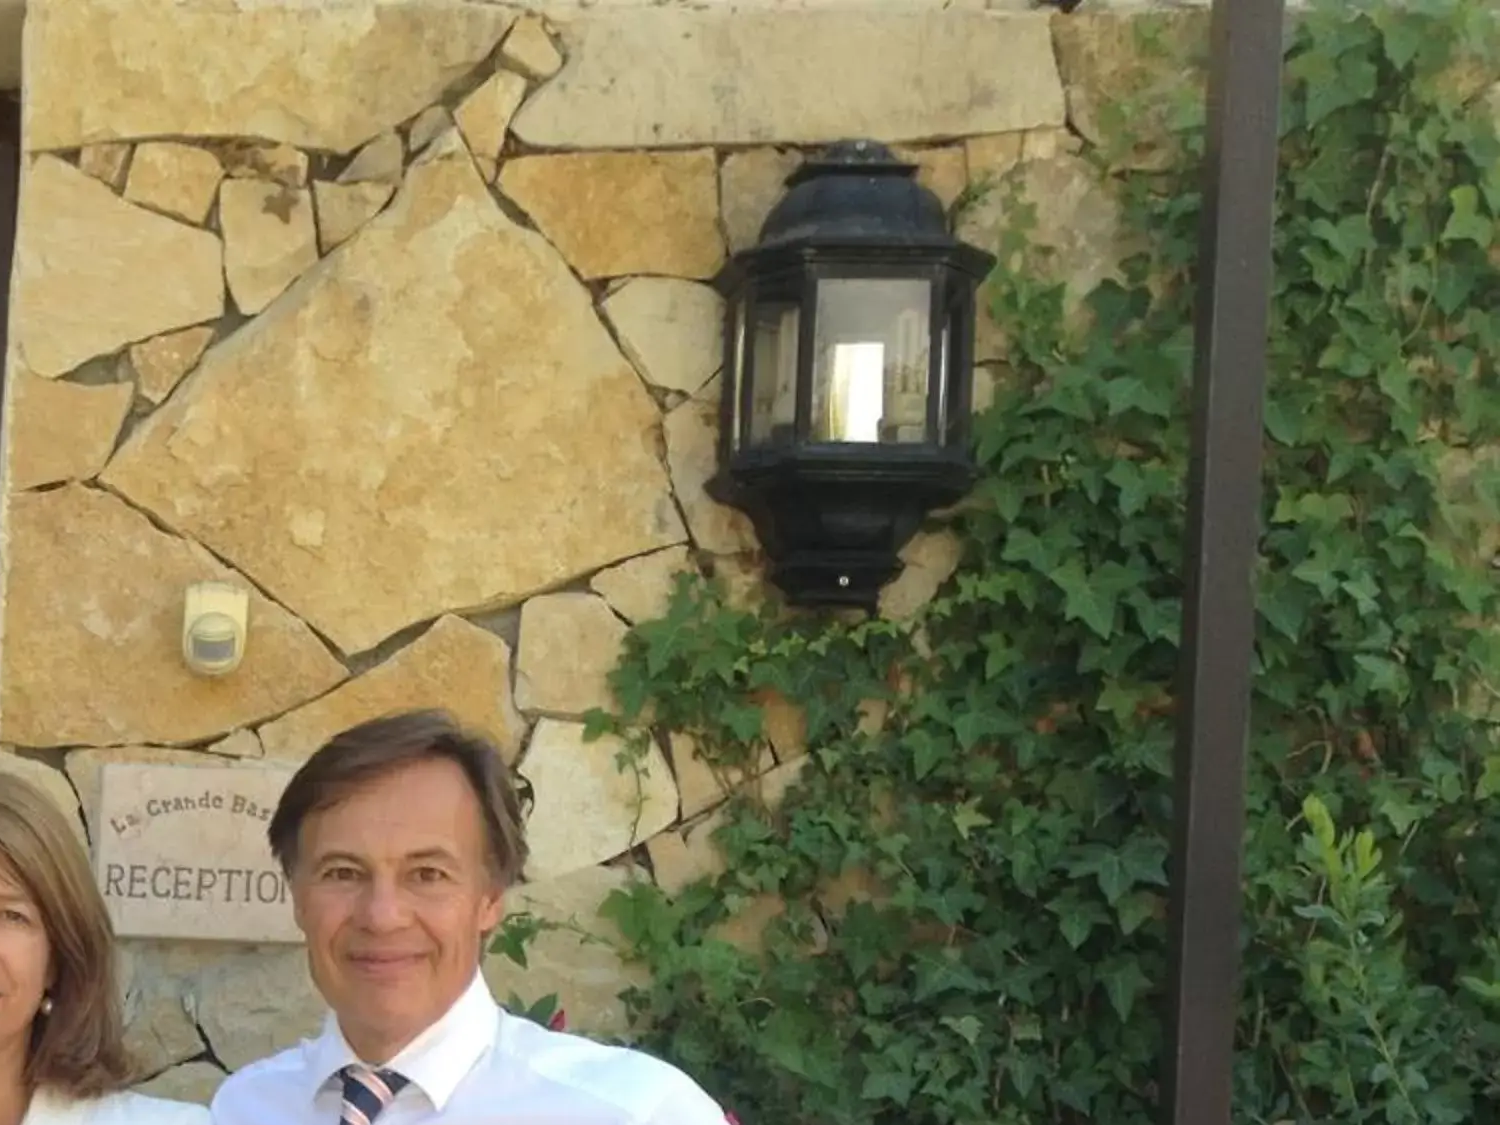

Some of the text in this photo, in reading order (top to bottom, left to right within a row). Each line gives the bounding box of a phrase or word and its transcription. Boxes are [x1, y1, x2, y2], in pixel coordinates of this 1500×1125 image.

[109, 790, 273, 835] La Grande Bas
